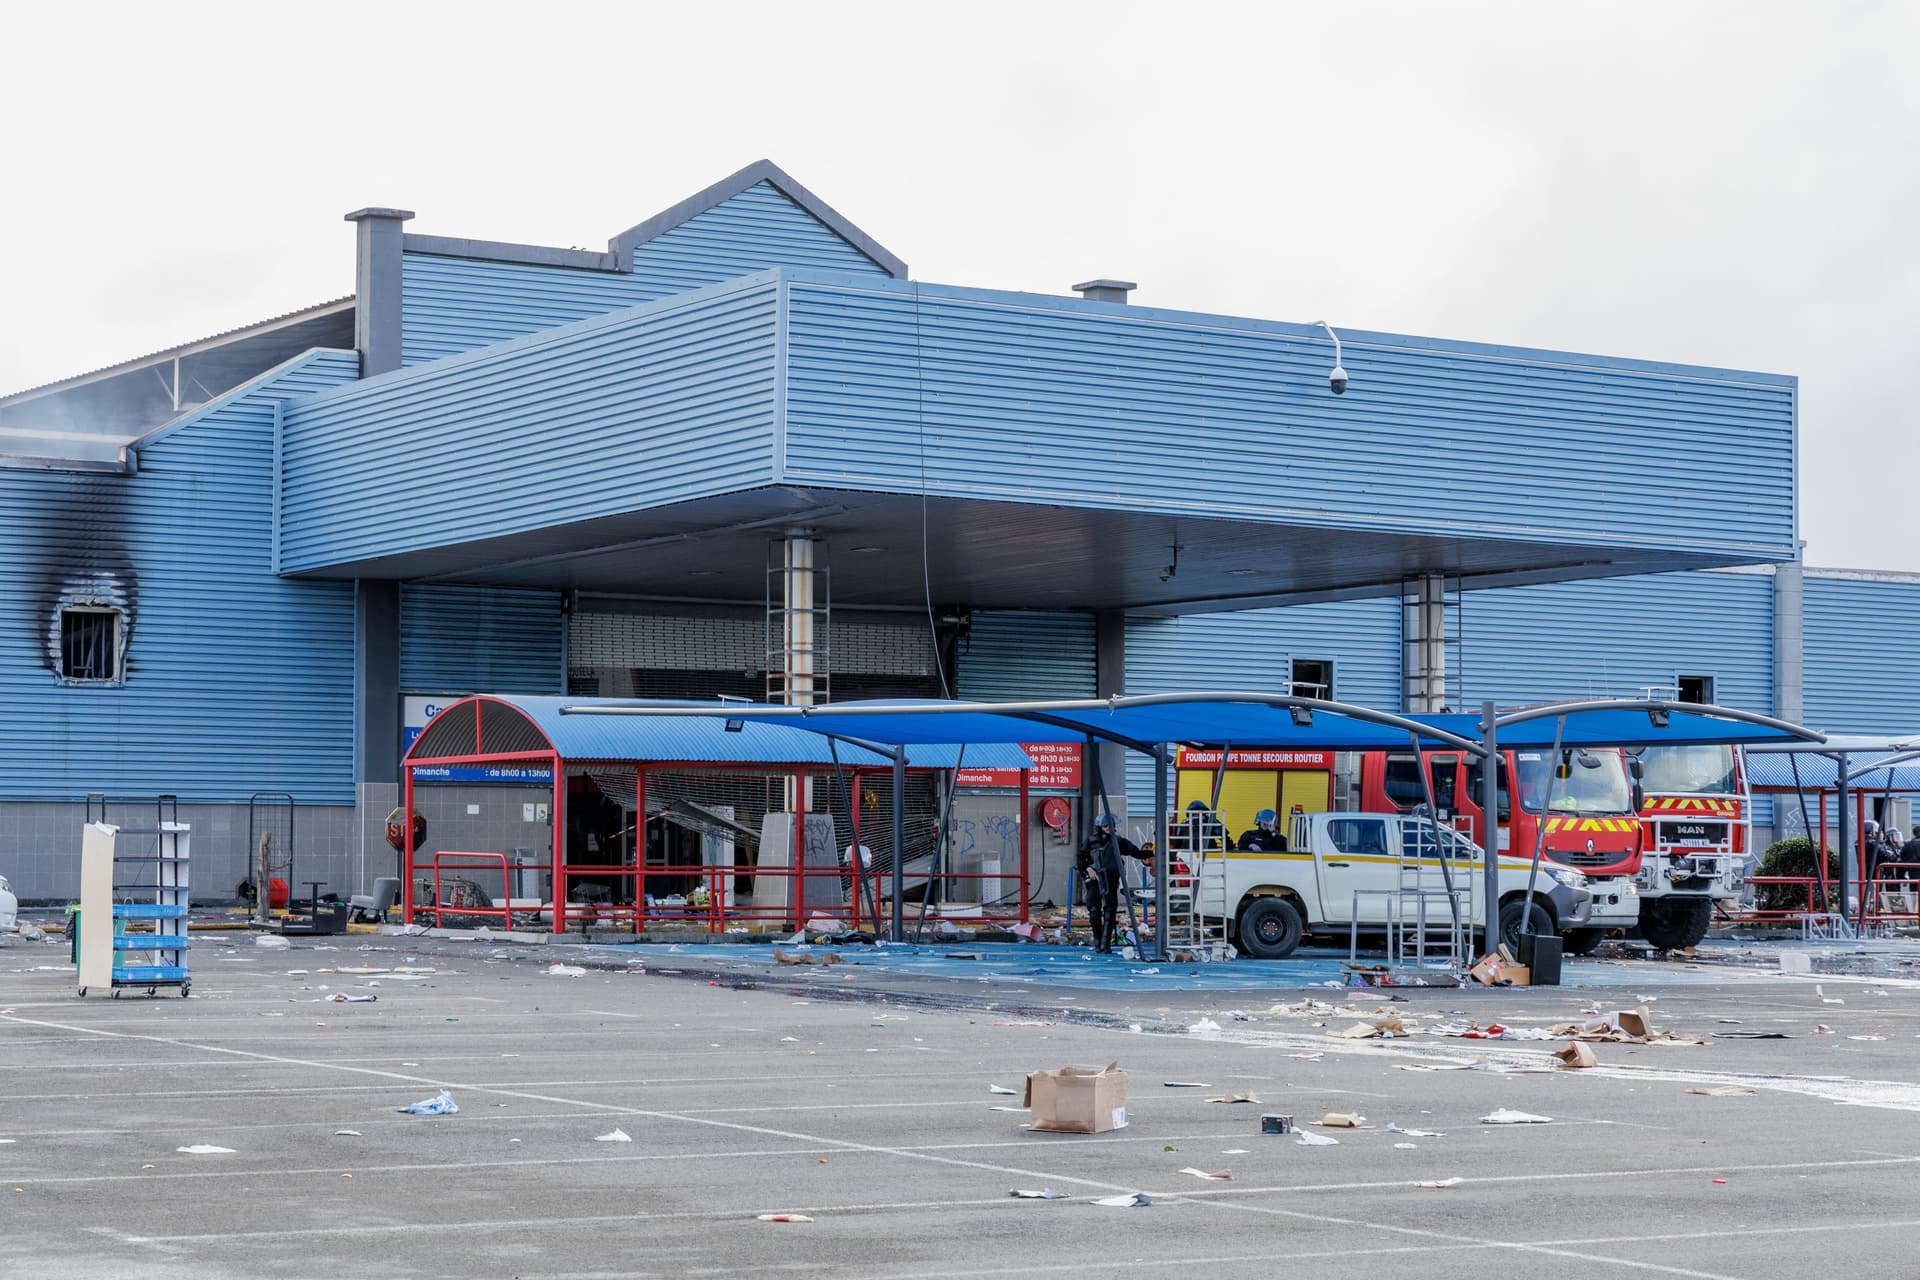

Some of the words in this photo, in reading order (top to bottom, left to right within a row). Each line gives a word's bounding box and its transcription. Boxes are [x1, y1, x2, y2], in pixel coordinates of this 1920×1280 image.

[1040, 755, 1058, 763] 8h30
[1185, 753, 1216, 763] FOURGON
[1239, 753, 1261, 763] TONNE
[1262, 753, 1293, 763] SECOURS
[1294, 754, 1324, 764] ROUTIER
[489, 769, 500, 777] de
[956, 773, 993, 782] Dimanche
[1030, 775, 1039, 783] de
